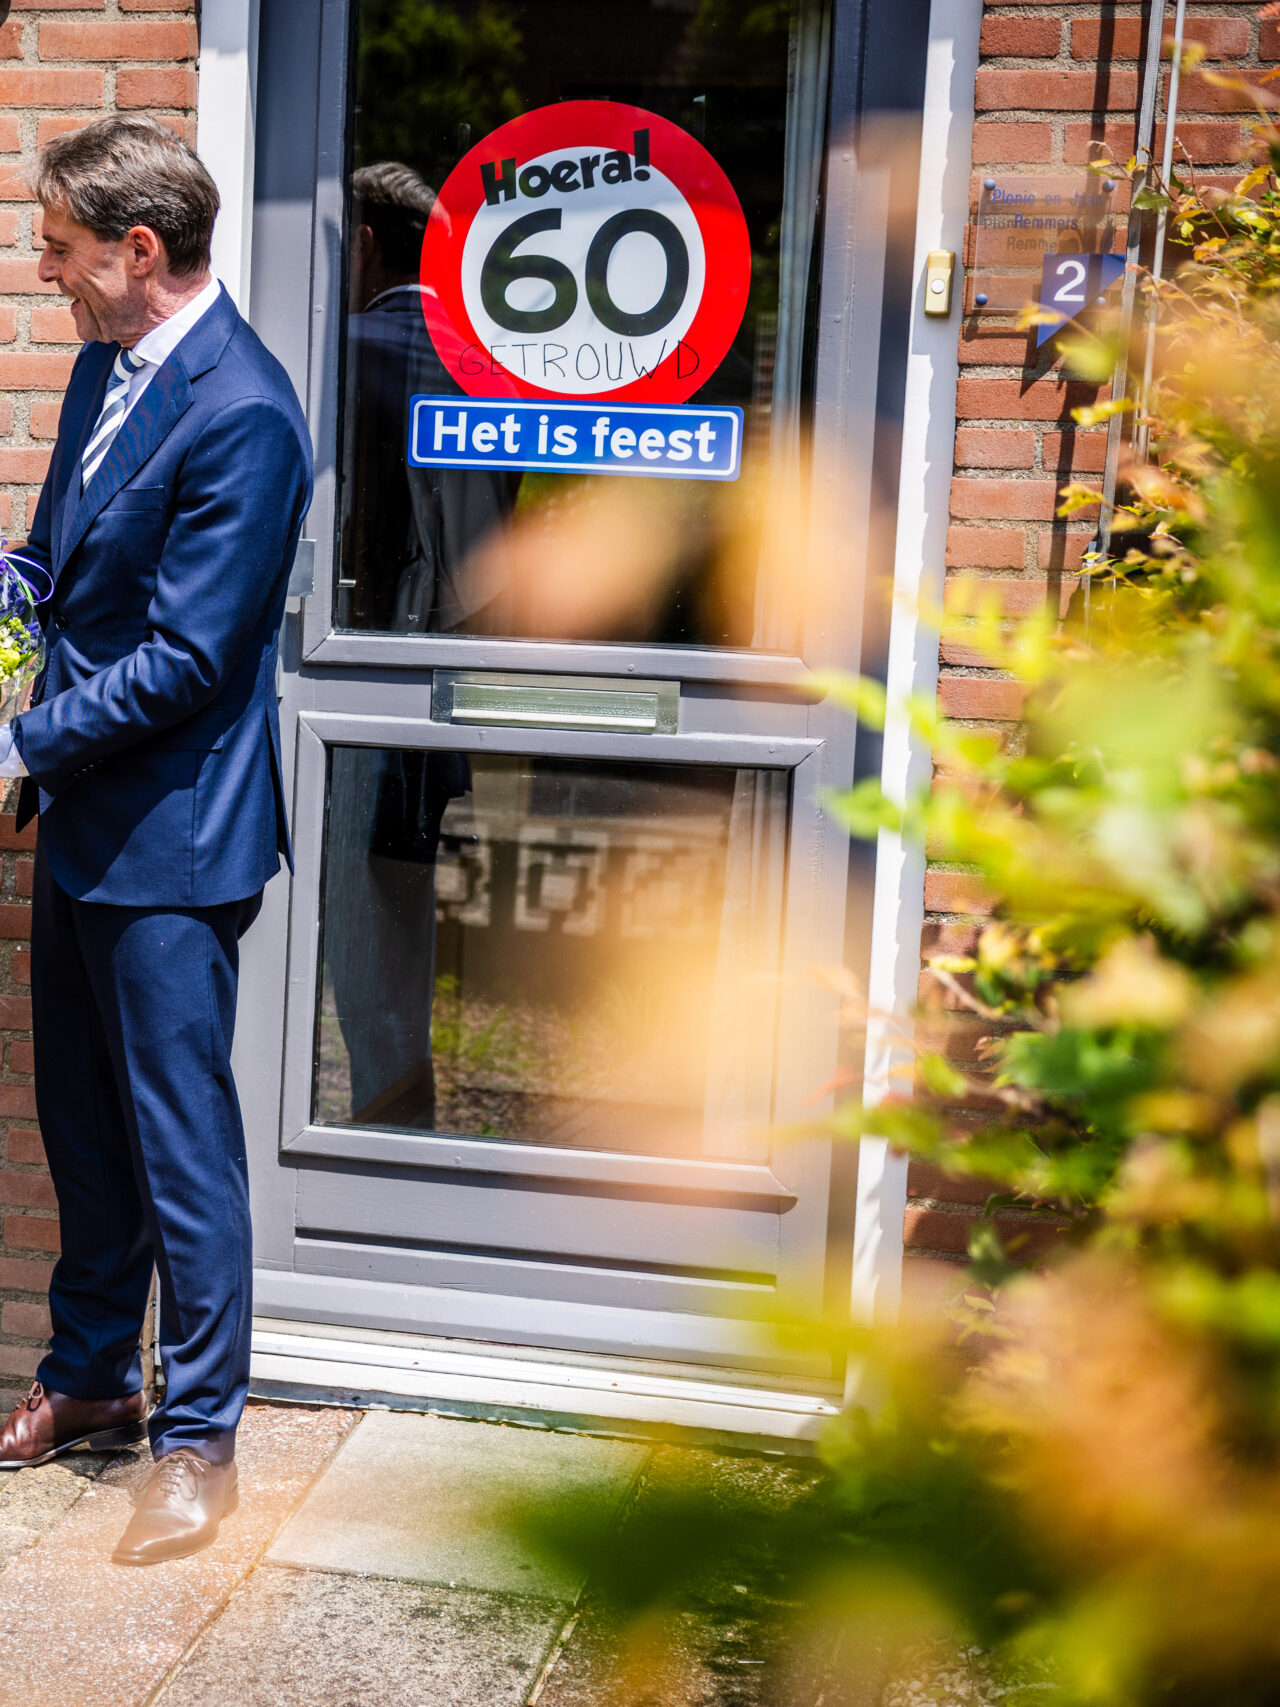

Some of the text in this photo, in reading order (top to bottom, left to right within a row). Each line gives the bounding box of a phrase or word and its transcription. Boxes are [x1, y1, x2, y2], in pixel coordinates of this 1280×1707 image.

[480, 128, 651, 206] Hoera!
[992, 188, 1036, 206] Plonie
[1044, 193, 1062, 206] en
[1013, 213, 1078, 230] Remmers
[480, 208, 689, 337] 60
[1053, 260, 1086, 302] 2
[459, 339, 699, 381] GETROUWD
[433, 410, 717, 463] Het is feest
